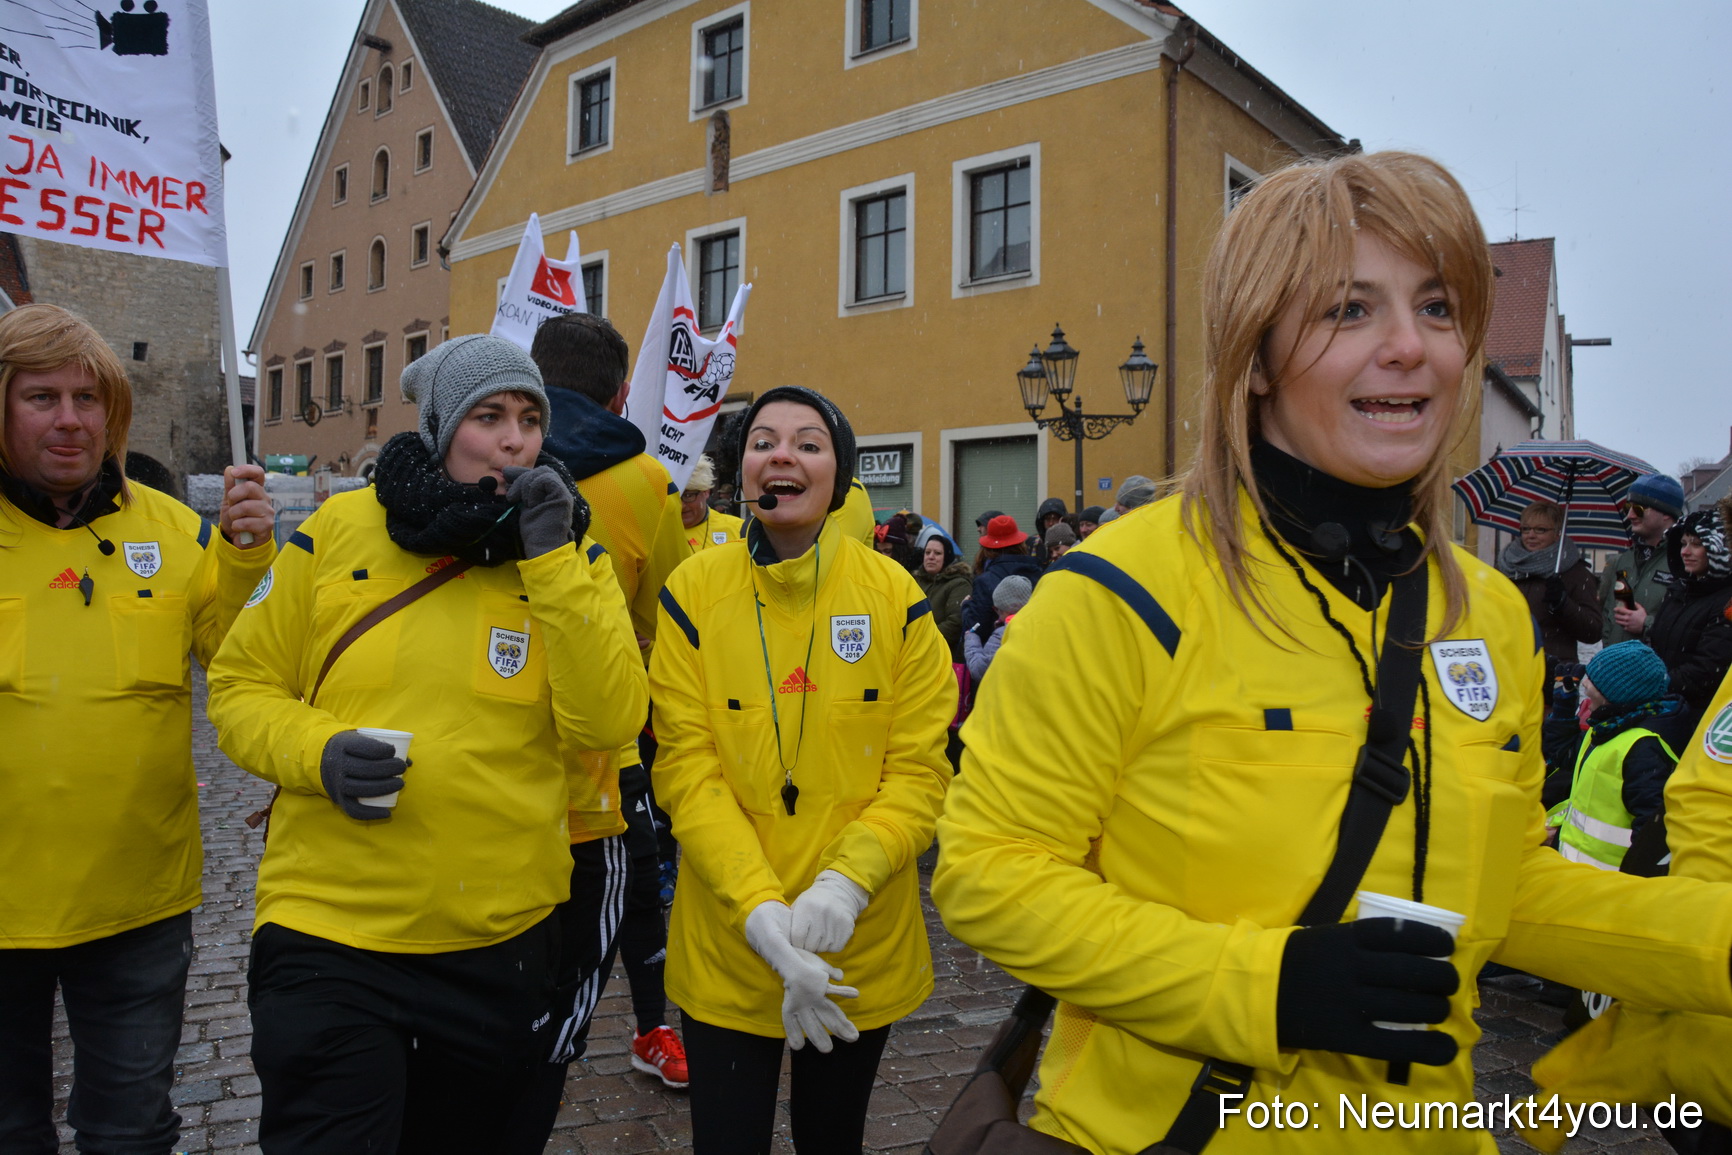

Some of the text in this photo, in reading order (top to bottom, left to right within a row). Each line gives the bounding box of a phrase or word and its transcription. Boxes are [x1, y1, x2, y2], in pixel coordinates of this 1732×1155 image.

[5, 134, 208, 215] JA IMMER
[527, 295, 552, 310] VIDEO
[498, 302, 533, 326] KOAN
[658, 443, 689, 466] SPORT
[861, 454, 898, 471] BW
[859, 474, 900, 485] Bekleidung
[495, 632, 525, 644] SCHEISS
[1439, 647, 1482, 658] SCHEISS
[499, 666, 515, 675] 2018
[778, 683, 818, 694] adidas
[1468, 702, 1490, 712] 2018
